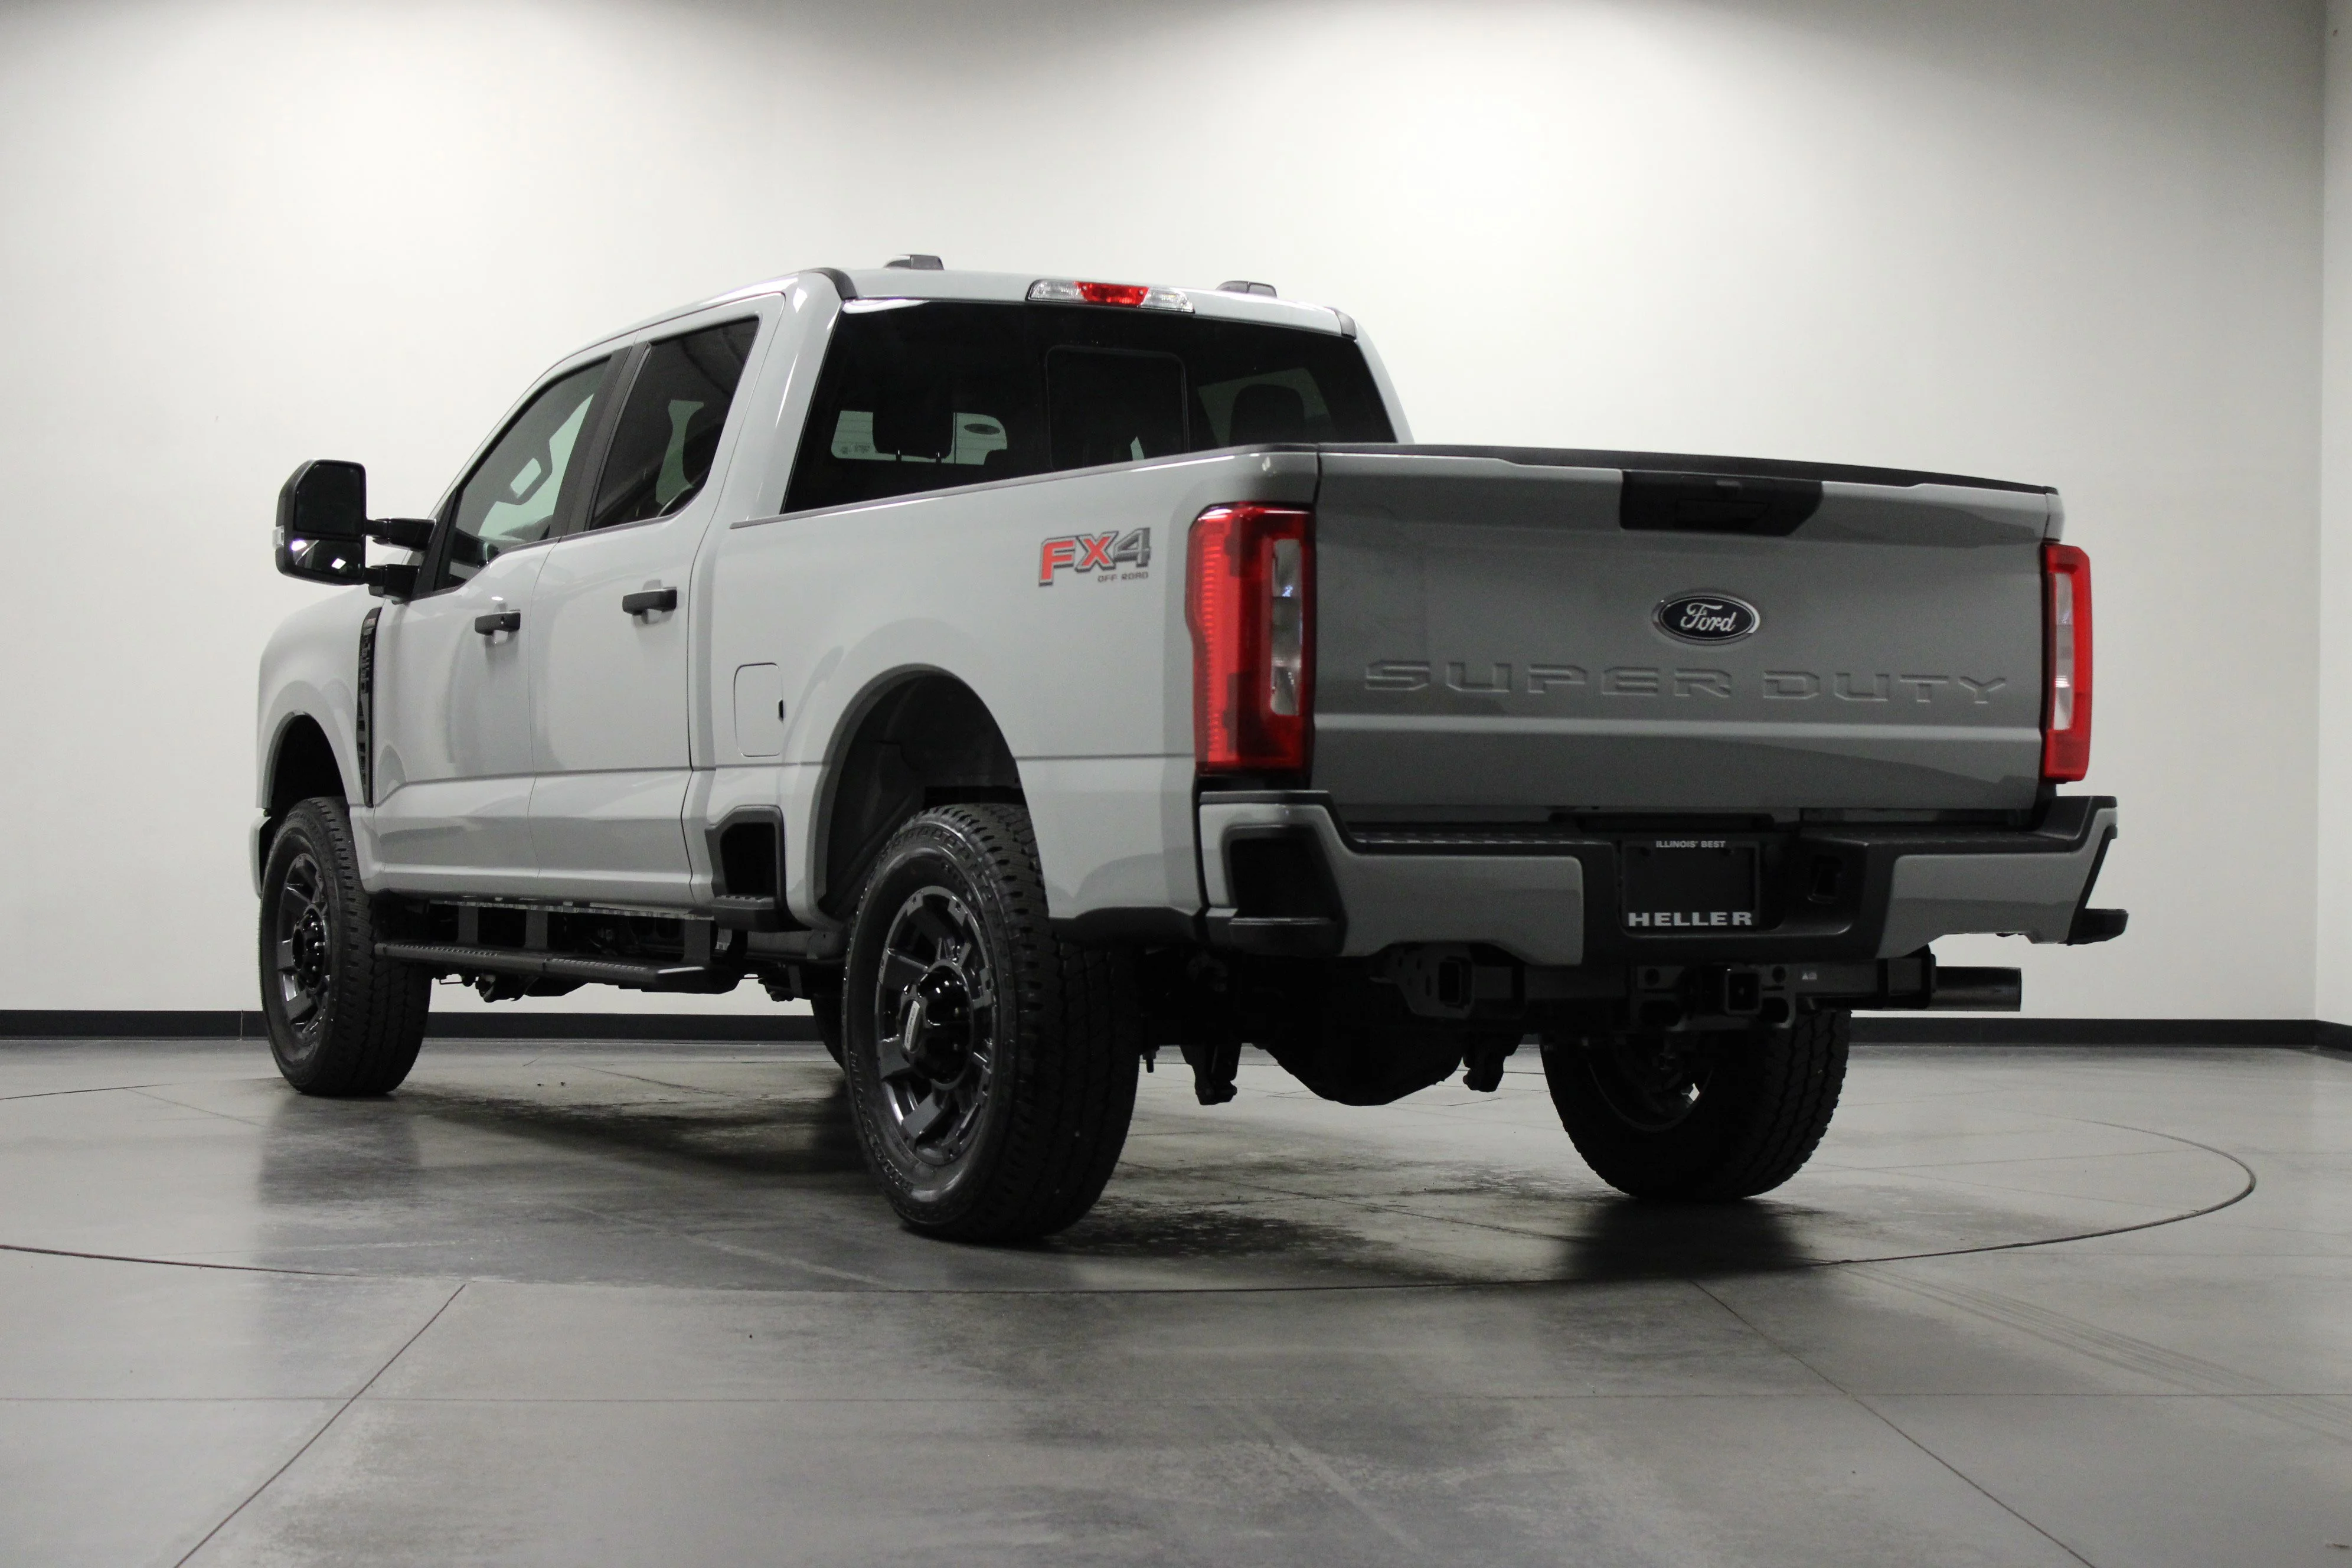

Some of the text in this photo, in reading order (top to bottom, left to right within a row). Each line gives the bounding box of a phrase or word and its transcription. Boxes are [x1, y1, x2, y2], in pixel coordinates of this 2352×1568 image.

[1038, 527, 1151, 586] FX4
[1097, 571, 1148, 583] OFF ROAD
[1680, 602, 1737, 632] Ford
[1364, 659, 2007, 704] SUPER DUTY
[1700, 840, 1726, 848] BEST
[1628, 912, 1753, 927] HELLER
